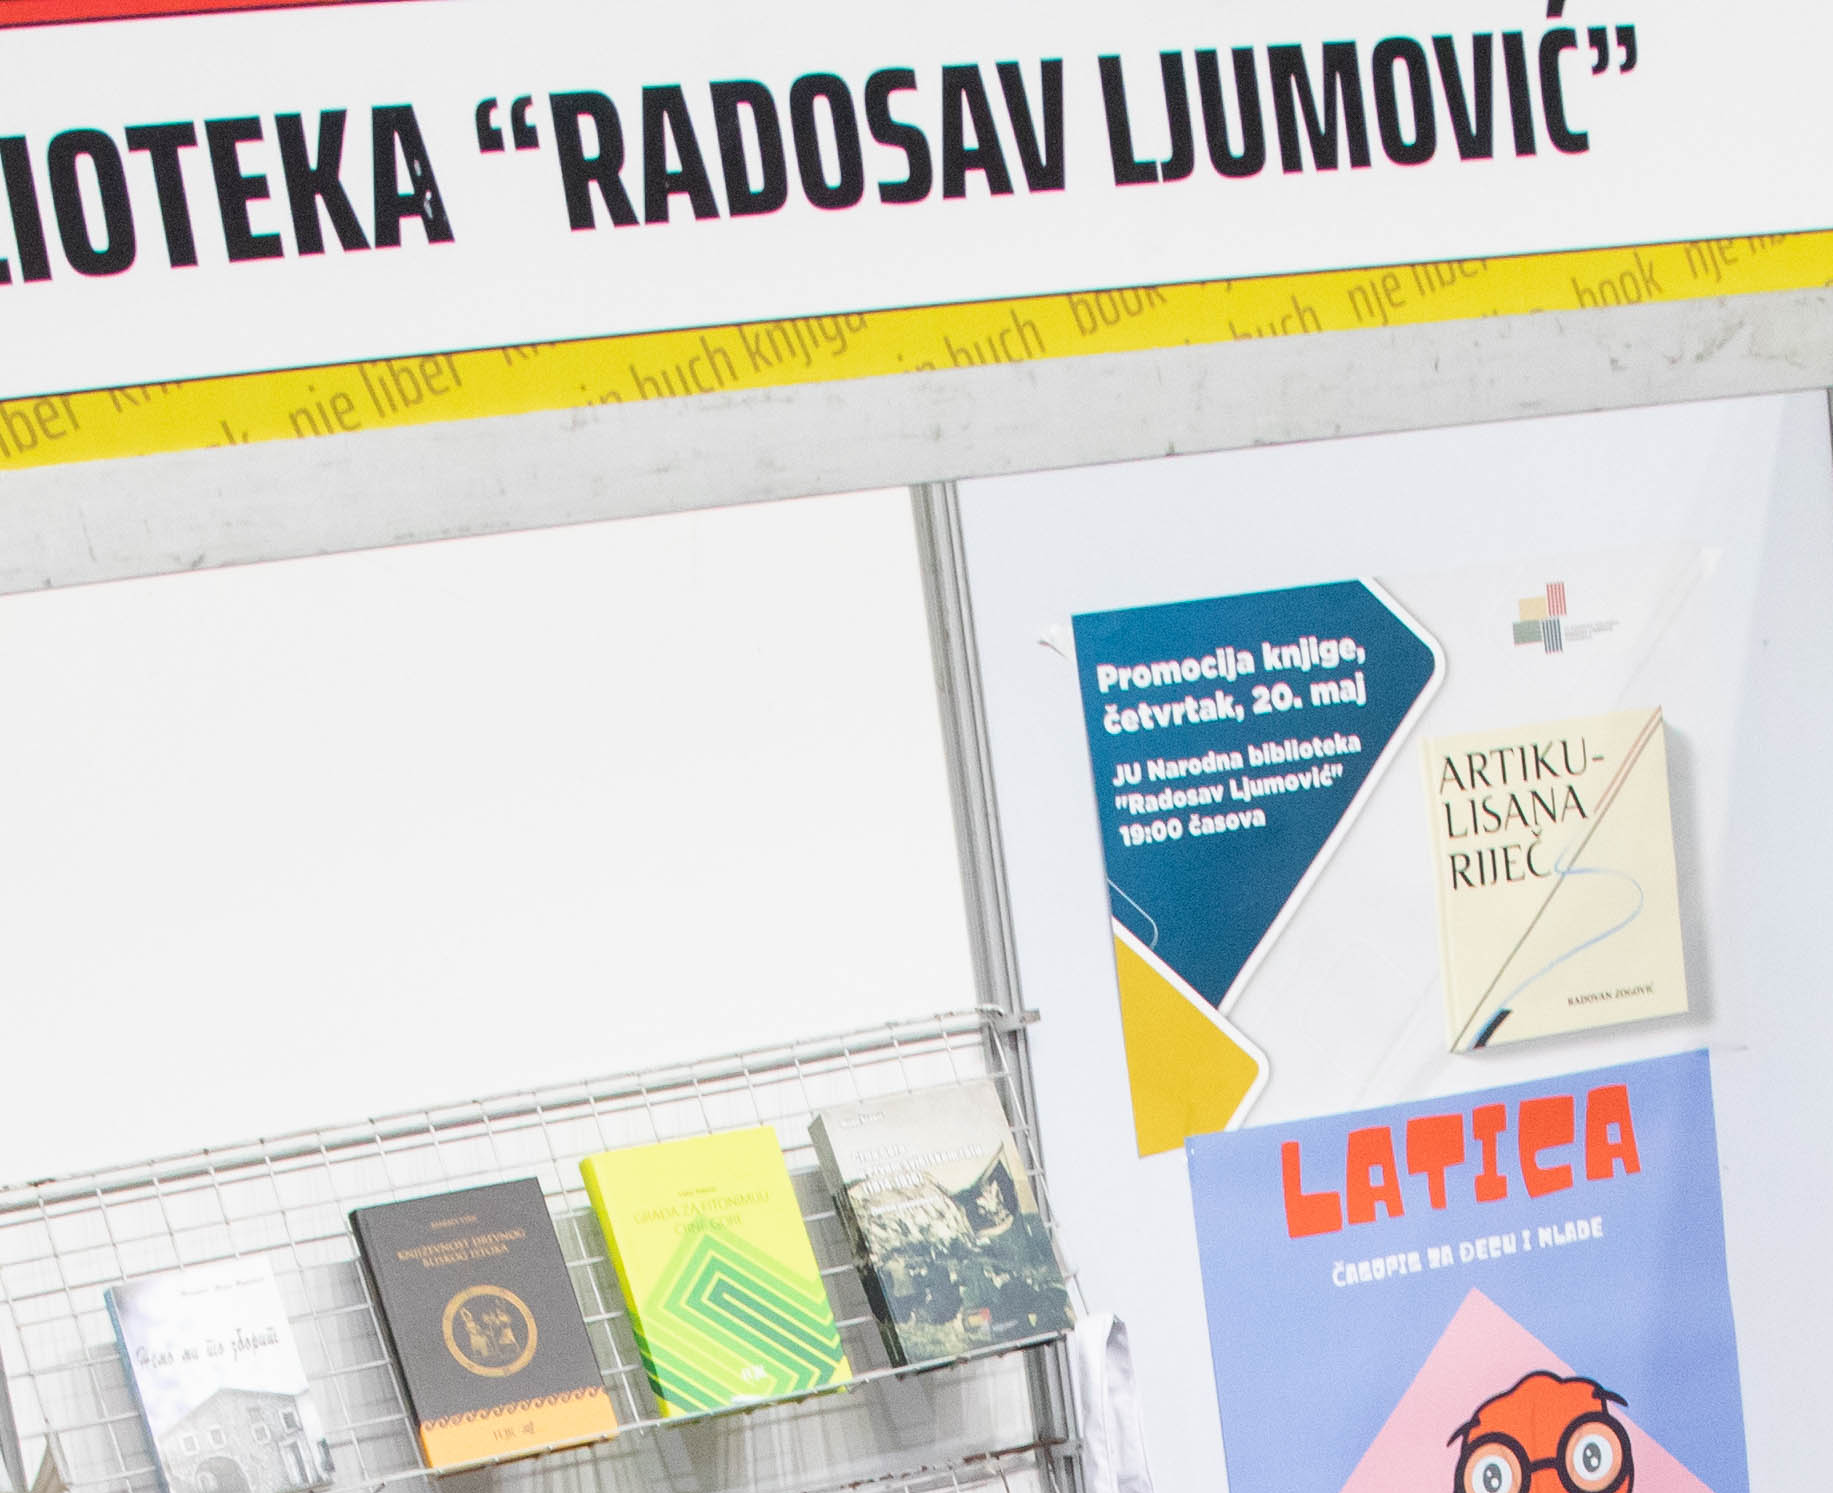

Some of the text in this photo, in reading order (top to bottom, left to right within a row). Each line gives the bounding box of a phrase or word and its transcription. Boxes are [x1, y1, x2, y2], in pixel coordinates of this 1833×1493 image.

[476, 60, 1064, 230] “RADOSAV
[1099, 0, 1637, 185] LJUMOVIĆ”
[1096, 635, 1366, 693] Promocija knjige,
[1104, 671, 1367, 735] četvrtak, 20. maj
[1113, 732, 1362, 787] JU Narodna biblioteka
[1439, 737, 1605, 795] ARTIKU-
[1115, 782, 1224, 816] "Radosav
[1119, 808, 1267, 847] 19:00 časova
[1444, 784, 1589, 839] LISANA
[1449, 826, 1551, 890] RIJEČ
[1281, 1083, 1641, 1239] LATICA
[1522, 1229, 1533, 1252] I
